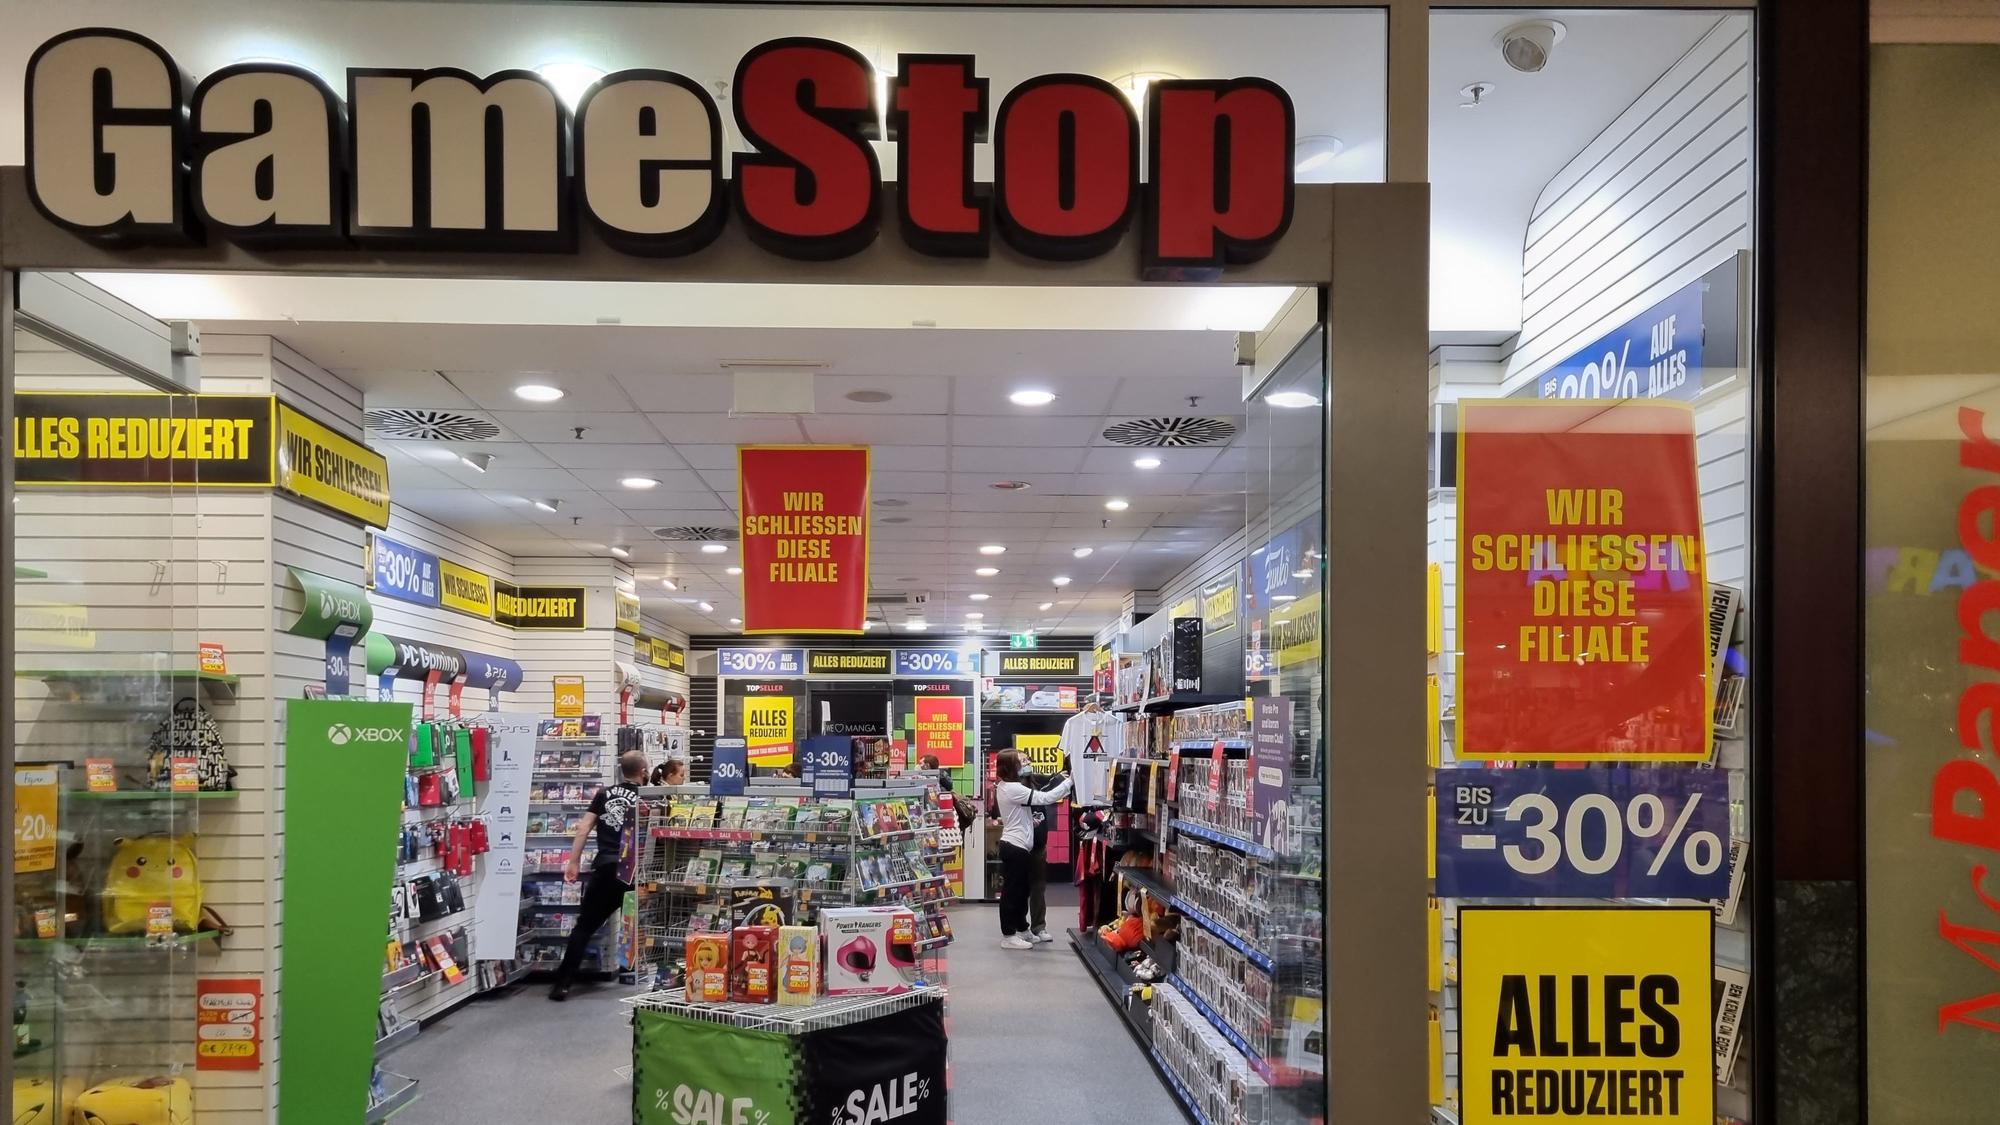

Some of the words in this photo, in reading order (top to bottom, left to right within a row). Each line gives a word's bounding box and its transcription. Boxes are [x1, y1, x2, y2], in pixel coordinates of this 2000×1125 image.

[26, 28, 1295, 268] GameStop
[1650, 314, 1677, 360] AUF
[1648, 349, 1687, 399] ALLES
[14, 417, 79, 460] LLES
[88, 417, 254, 461] REDUZIERT
[286, 429, 313, 481] WIR
[314, 444, 386, 509] SCHLIESSEN
[783, 492, 824, 511] WIR
[1546, 489, 1623, 525] WIR
[746, 516, 862, 535] SCHLIESSEN
[777, 539, 831, 559] DIESE
[1471, 534, 1696, 571] SCHLIESSEN
[379, 551, 420, 593] -30%
[770, 563, 838, 583] FILIALE
[443, 573, 456, 595] WIR
[456, 577, 488, 604] SCHLIESSEN
[1533, 580, 1636, 617] DIESE
[334, 598, 360, 621] XBOX
[1519, 626, 1649, 662] FILIALE
[327, 656, 349, 677] -30%
[400, 644, 419, 666] PC
[420, 647, 460, 677] Gaming
[724, 653, 776, 671] -30%
[781, 662, 797, 671] ALLES
[813, 655, 842, 668] ALLES
[843, 656, 886, 668] REDUZIERT
[901, 653, 952, 671] -30%
[1004, 658, 1028, 670] ALLES
[1030, 658, 1075, 670] REDUZIERT
[493, 667, 507, 679] PS4
[750, 710, 787, 726] ALLES
[918, 723, 962, 731] SCHLIESSEN
[355, 728, 404, 742] XBOX
[750, 728, 787, 738] REDUZIERT
[845, 724, 876, 732] MANGA
[927, 741, 952, 749] FILIALE
[816, 752, 849, 766] -30%
[1024, 748, 1057, 762] ALLES
[713, 763, 744, 778] -30%
[1031, 765, 1058, 775] DUZIERT
[1456, 787, 1491, 805] BIS
[1457, 808, 1488, 825] ZU
[1461, 793, 1723, 875] -30%
[1728, 984, 1743, 998] BEN
[1493, 974, 1680, 1058] ALLES
[1721, 999, 1739, 1024] KENOBI
[1718, 1025, 1733, 1035] ON
[846, 1071, 918, 1125] SALE
[1491, 1070, 1684, 1116] REDUZIERT
[671, 1084, 754, 1125] SALE
